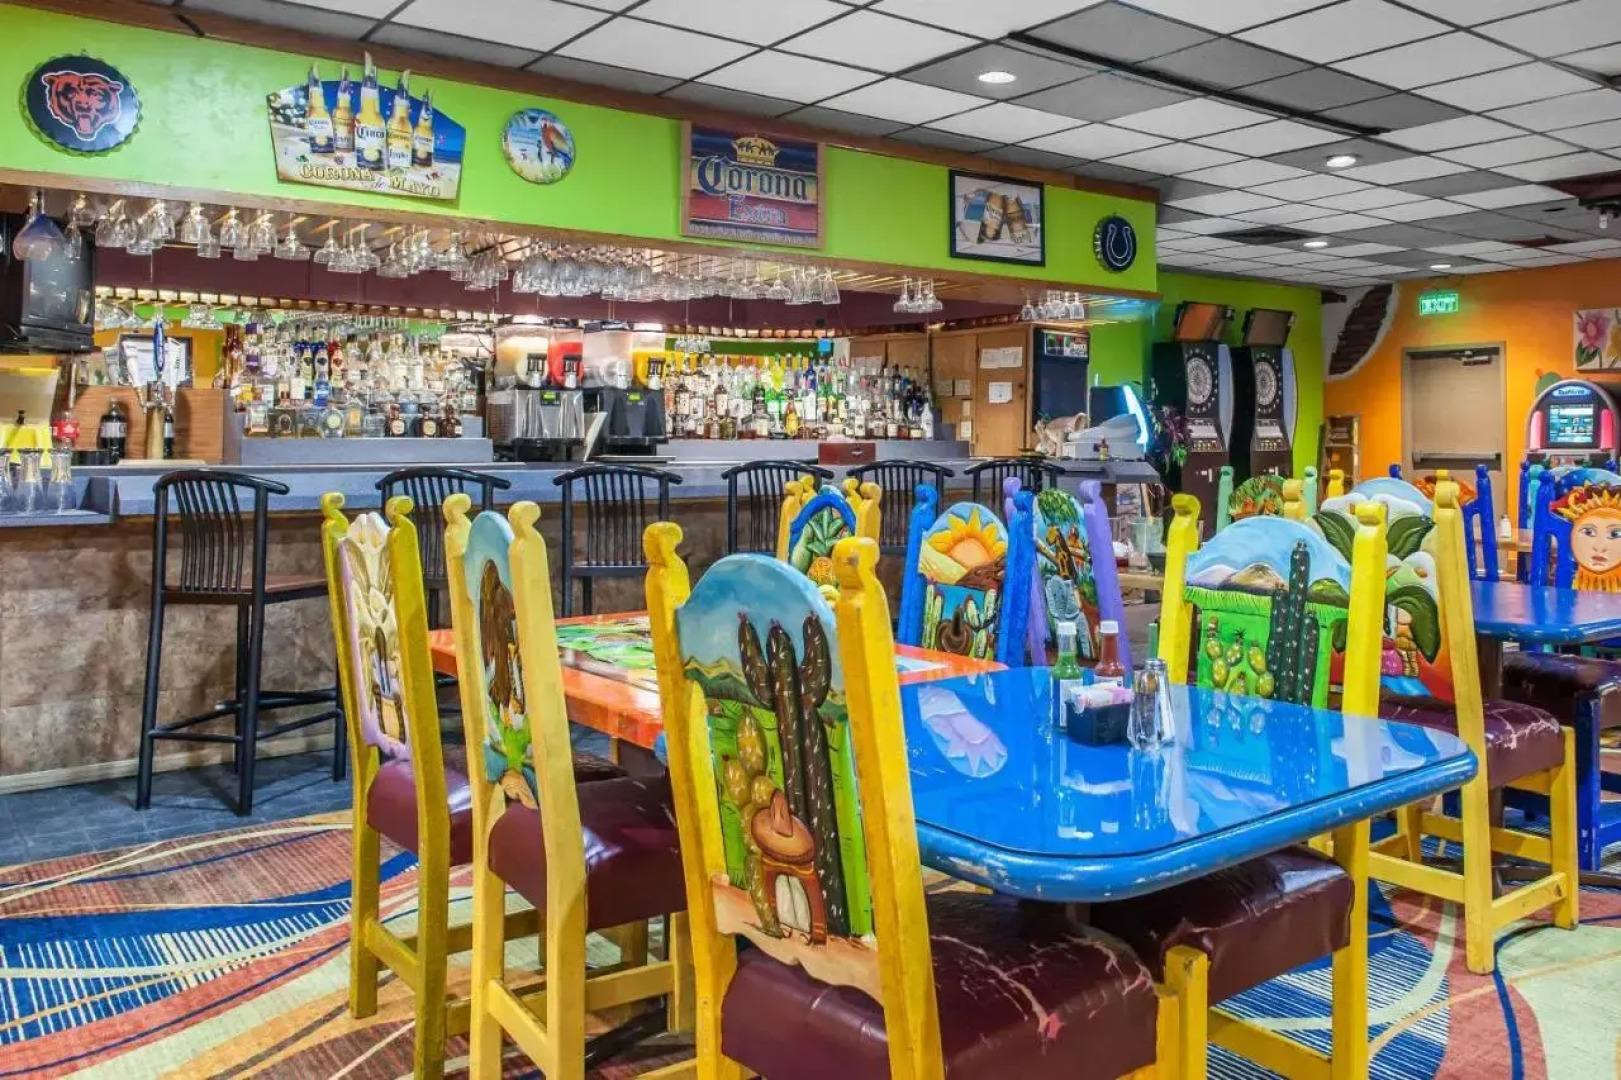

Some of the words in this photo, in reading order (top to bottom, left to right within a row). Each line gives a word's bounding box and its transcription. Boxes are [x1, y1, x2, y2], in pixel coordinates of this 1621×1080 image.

[356, 126, 385, 139] Cinco
[698, 155, 807, 200] Corona
[728, 195, 788, 225] Extra
[1421, 298, 1455, 315] EXIT
